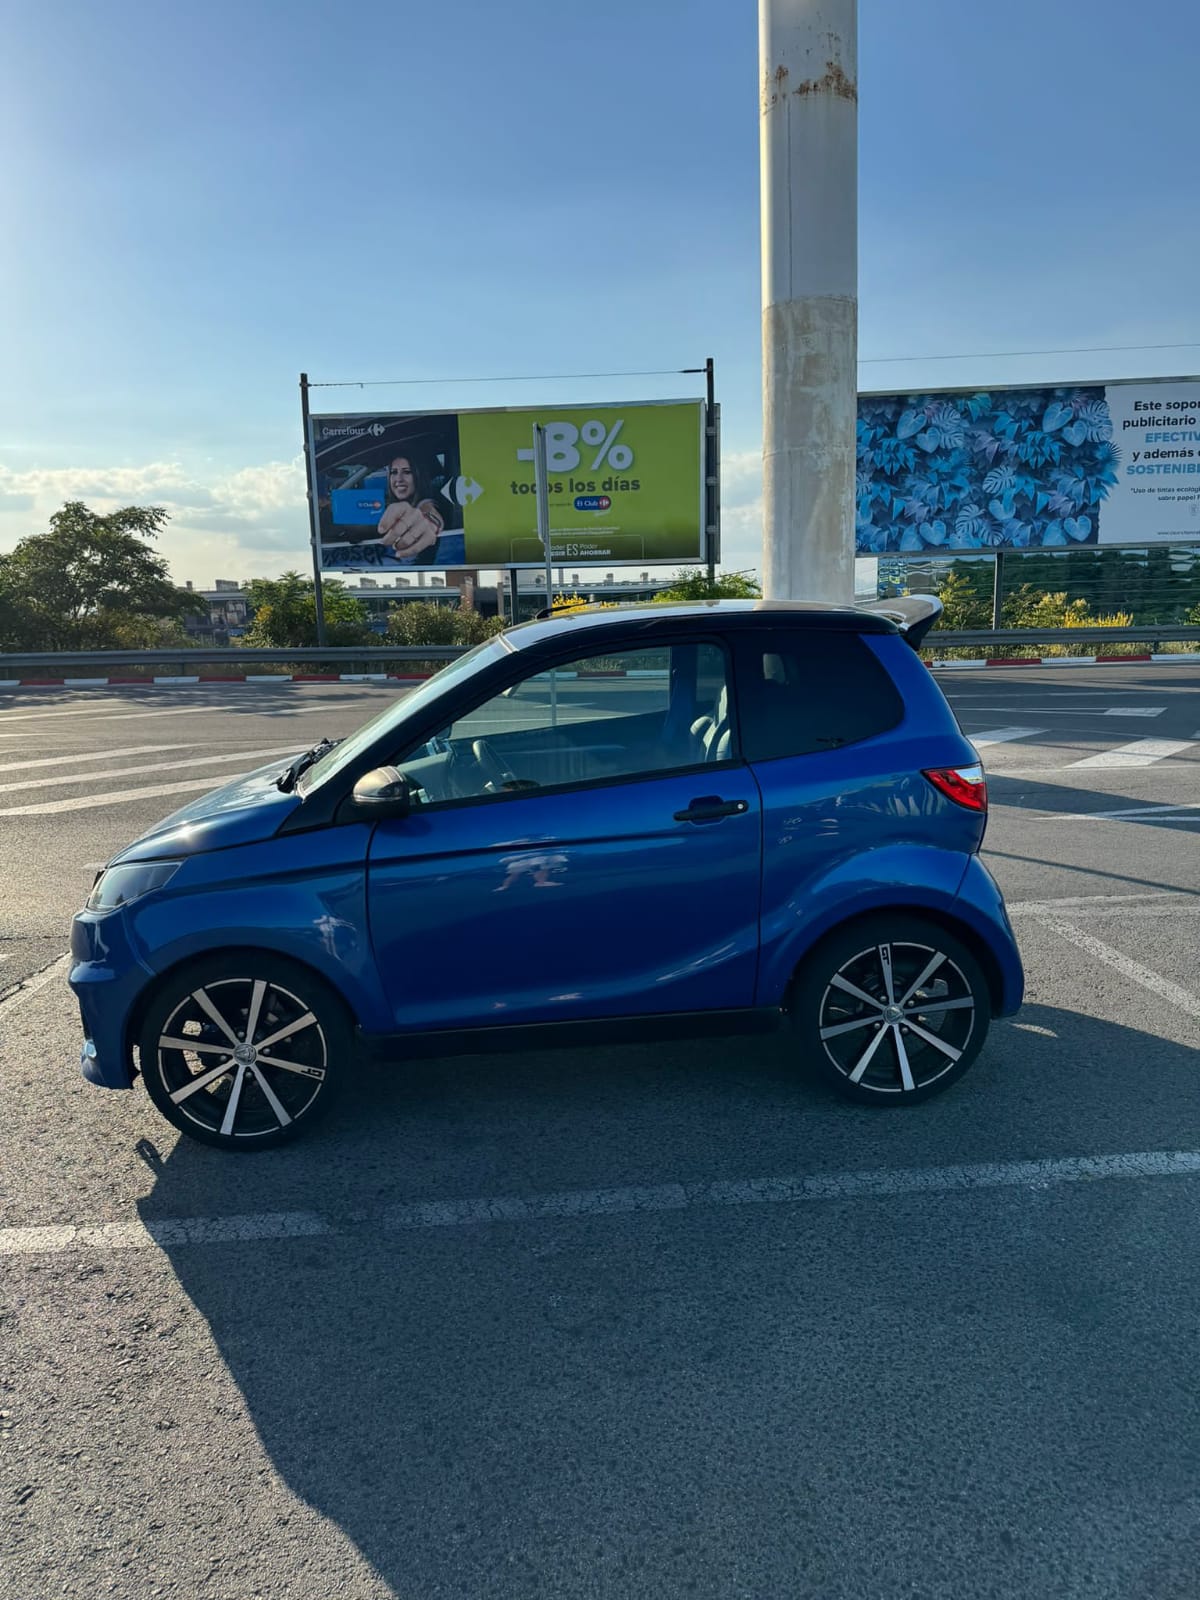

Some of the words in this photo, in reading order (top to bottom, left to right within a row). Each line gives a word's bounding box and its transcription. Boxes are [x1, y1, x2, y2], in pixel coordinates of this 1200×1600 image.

[1134, 400, 1162, 411] Este
[1122, 415, 1196, 430] publicitario
[322, 425, 365, 436] Carrefour
[1132, 452, 1141, 462] y
[1144, 447, 1194, 459] además
[569, 478, 596, 493] los
[602, 476, 640, 492] días
[1177, 494, 1196, 502] papel
[566, 543, 578, 556] ES
